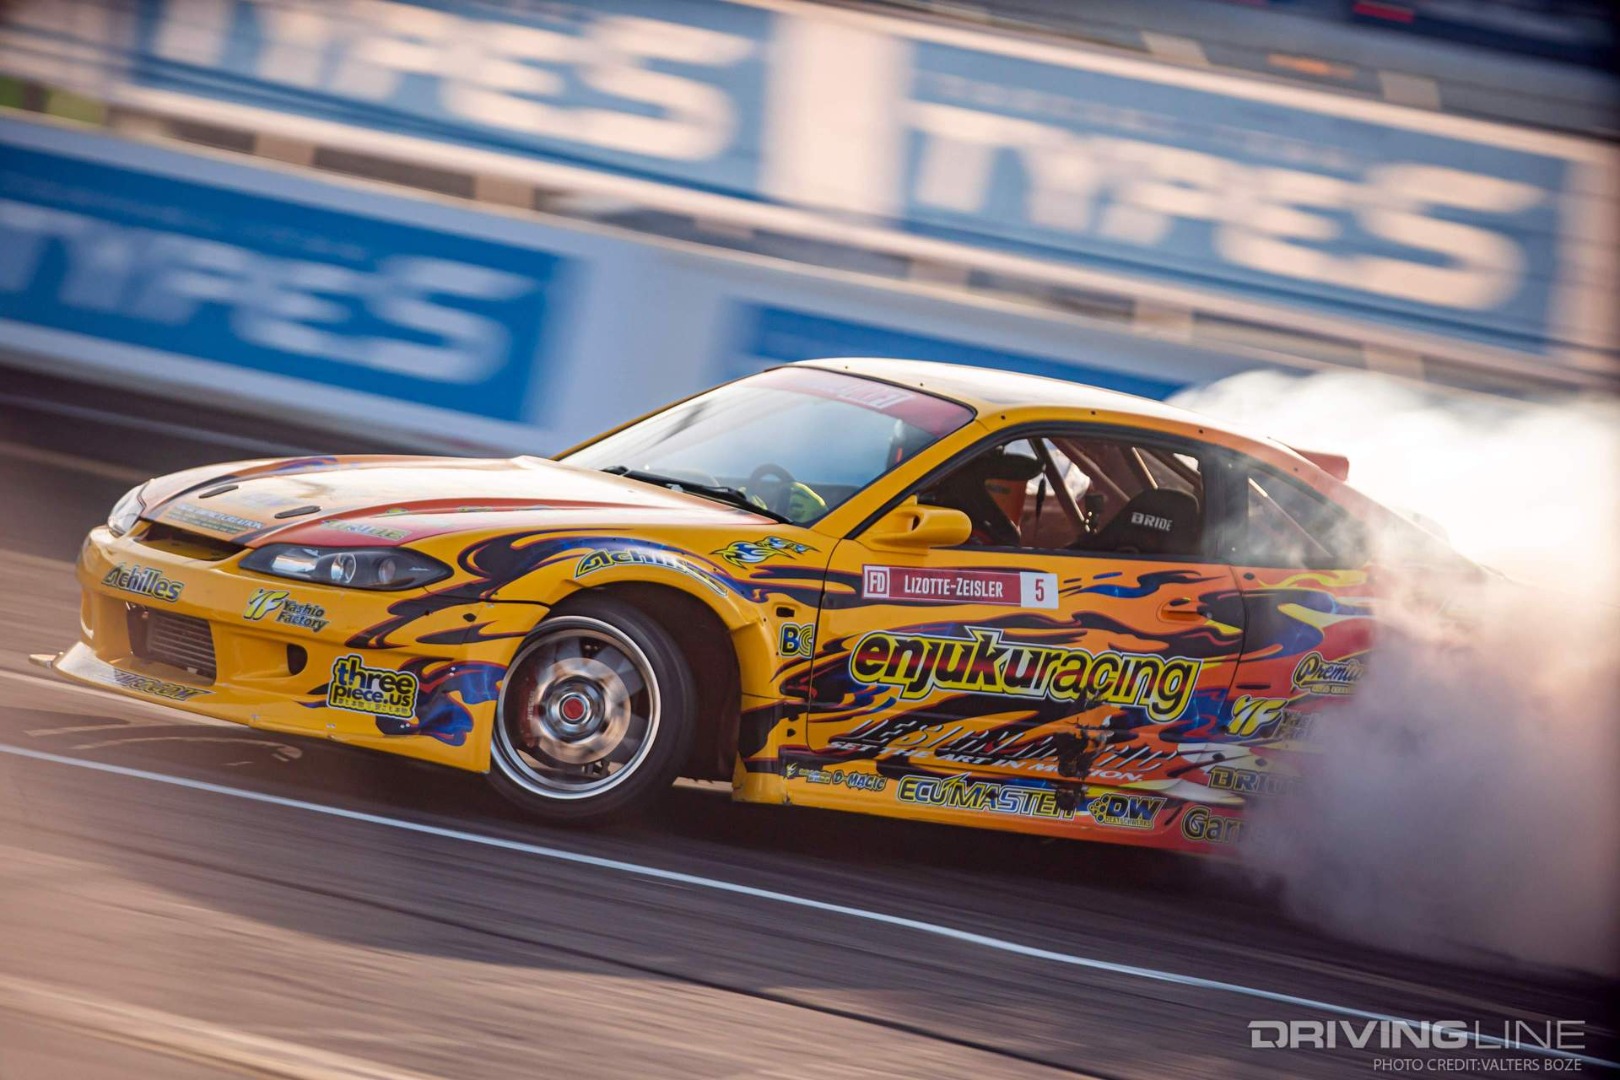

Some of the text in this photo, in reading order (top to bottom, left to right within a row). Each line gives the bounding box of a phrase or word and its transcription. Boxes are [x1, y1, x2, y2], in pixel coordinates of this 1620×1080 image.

[1131, 511, 1173, 532] BRIDE
[102, 562, 185, 603] Achilles
[869, 571, 887, 593] FD
[904, 574, 1004, 598] LIZOTTE-ZEISLER
[1034, 578, 1045, 602] 5
[282, 600, 325, 617] Yashio
[277, 611, 330, 633] Factory
[337, 660, 414, 695] three
[850, 628, 1203, 723] enjukuracing
[332, 685, 411, 707] piece.us
[830, 740, 875, 752] SET
[880, 746, 932, 758] THE
[937, 753, 993, 766] ART
[992, 759, 1027, 769] IN
[1106, 796, 1165, 821] DW
